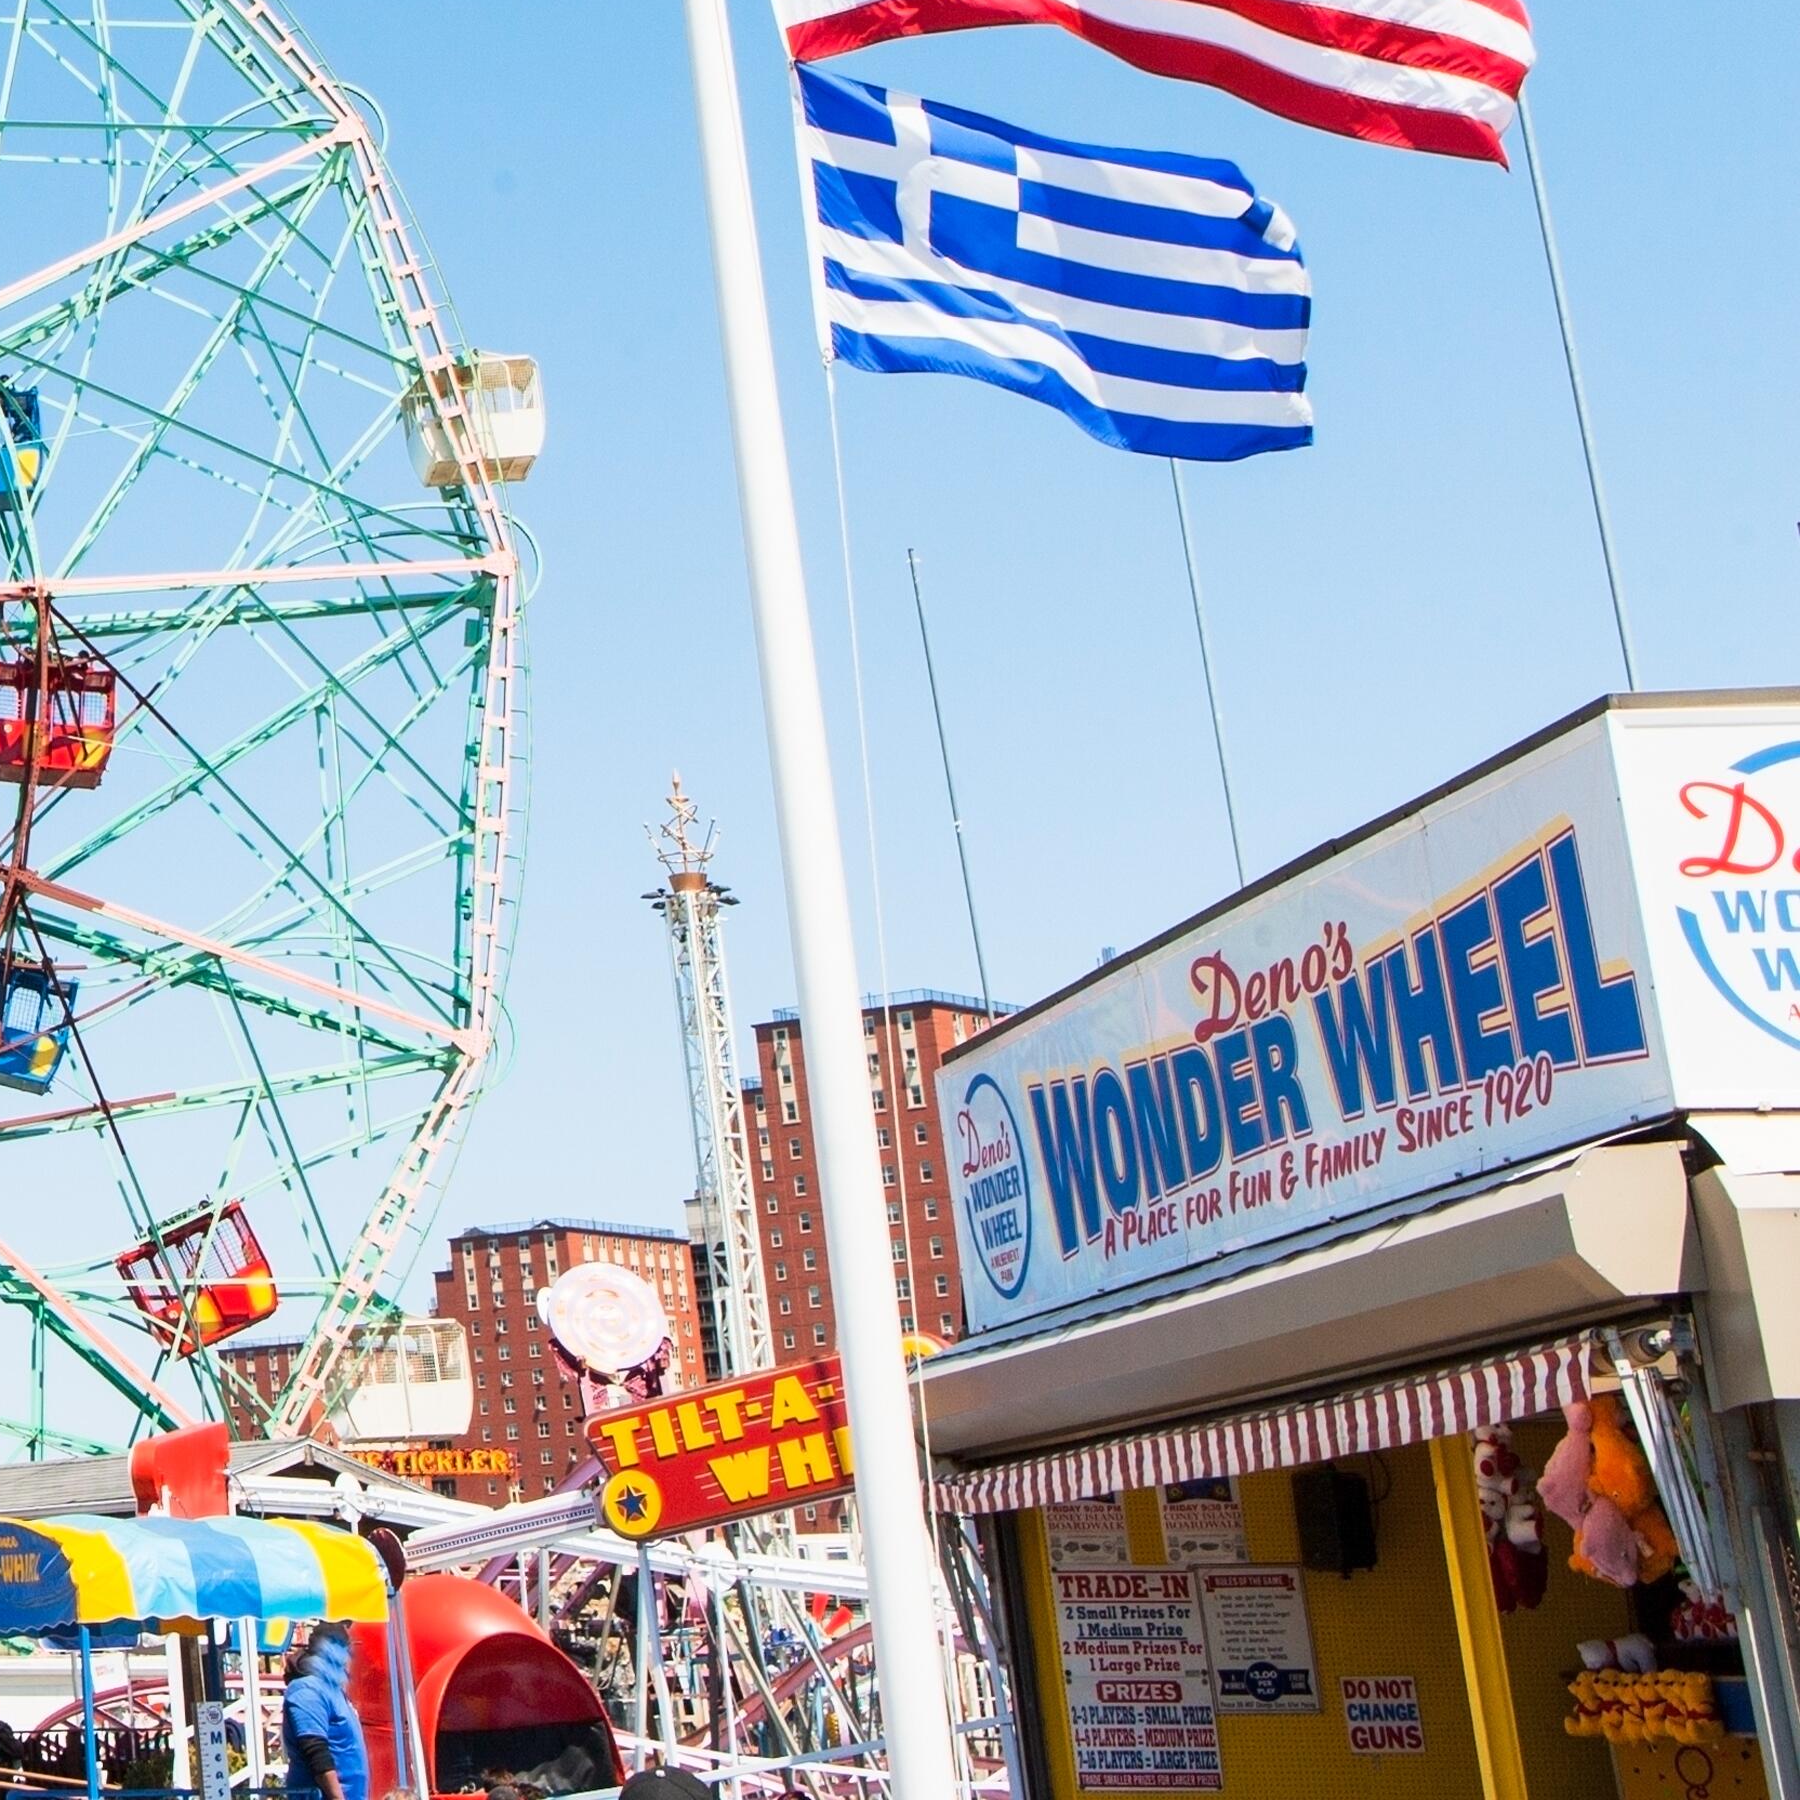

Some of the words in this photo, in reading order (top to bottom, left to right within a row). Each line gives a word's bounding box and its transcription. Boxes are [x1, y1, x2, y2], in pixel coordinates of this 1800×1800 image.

[1191, 921, 1353, 1042] Deno's
[1028, 1010, 1312, 1261] WONDER
[1311, 825, 1649, 1125] WHEEL
[957, 1109, 1011, 1178] Deno's
[1124, 1203, 1178, 1250] PLACE
[1186, 1188, 1223, 1230] FOR
[1229, 1169, 1271, 1214] FUN
[1280, 1151, 1299, 1199] &
[1305, 1127, 1386, 1189] FAMILY
[1396, 1095, 1474, 1152] SINCE
[1484, 1057, 1552, 1126] 1920
[970, 1165, 1022, 1213] WONDER
[980, 1208, 1022, 1250] WHEEL
[393, 1448, 510, 1475] TICKLER
[1066, 1607, 1073, 1619] 2
[1077, 1605, 1117, 1619] Small
[1120, 1605, 1165, 1619] Prizes
[1168, 1605, 1190, 1618] For
[1078, 1624, 1084, 1636] 1
[1088, 1623, 1143, 1636] Medium
[1146, 1623, 1183, 1636] Prize
[1063, 1642, 1071, 1654] 2
[1074, 1641, 1130, 1655] Medium
[1133, 1641, 1176, 1654] Prizes
[1180, 1641, 1202, 1654] For
[1090, 1660, 1096, 1671] 1
[1100, 1659, 1141, 1674] Large
[1144, 1659, 1180, 1671] Prize
[1102, 1684, 1176, 1700] PRIZES
[1343, 1680, 1370, 1699] DO
[1374, 1680, 1412, 1699] NOT
[1089, 1706, 1136, 1725] PLAYERS
[1144, 1706, 1181, 1725] SMALL
[1183, 1706, 1213, 1725] PRIZE
[1347, 1703, 1418, 1722] CHANGE
[1092, 1729, 1136, 1747] PLAYERS
[1144, 1728, 1185, 1747] MEDIUM
[1188, 1728, 1216, 1747] PRIZE
[1351, 1726, 1422, 1749] GUNS
[1099, 1751, 1143, 1769] PLAYERS
[1153, 1751, 1186, 1769] LARGE
[1188, 1751, 1218, 1769] PRIZE
